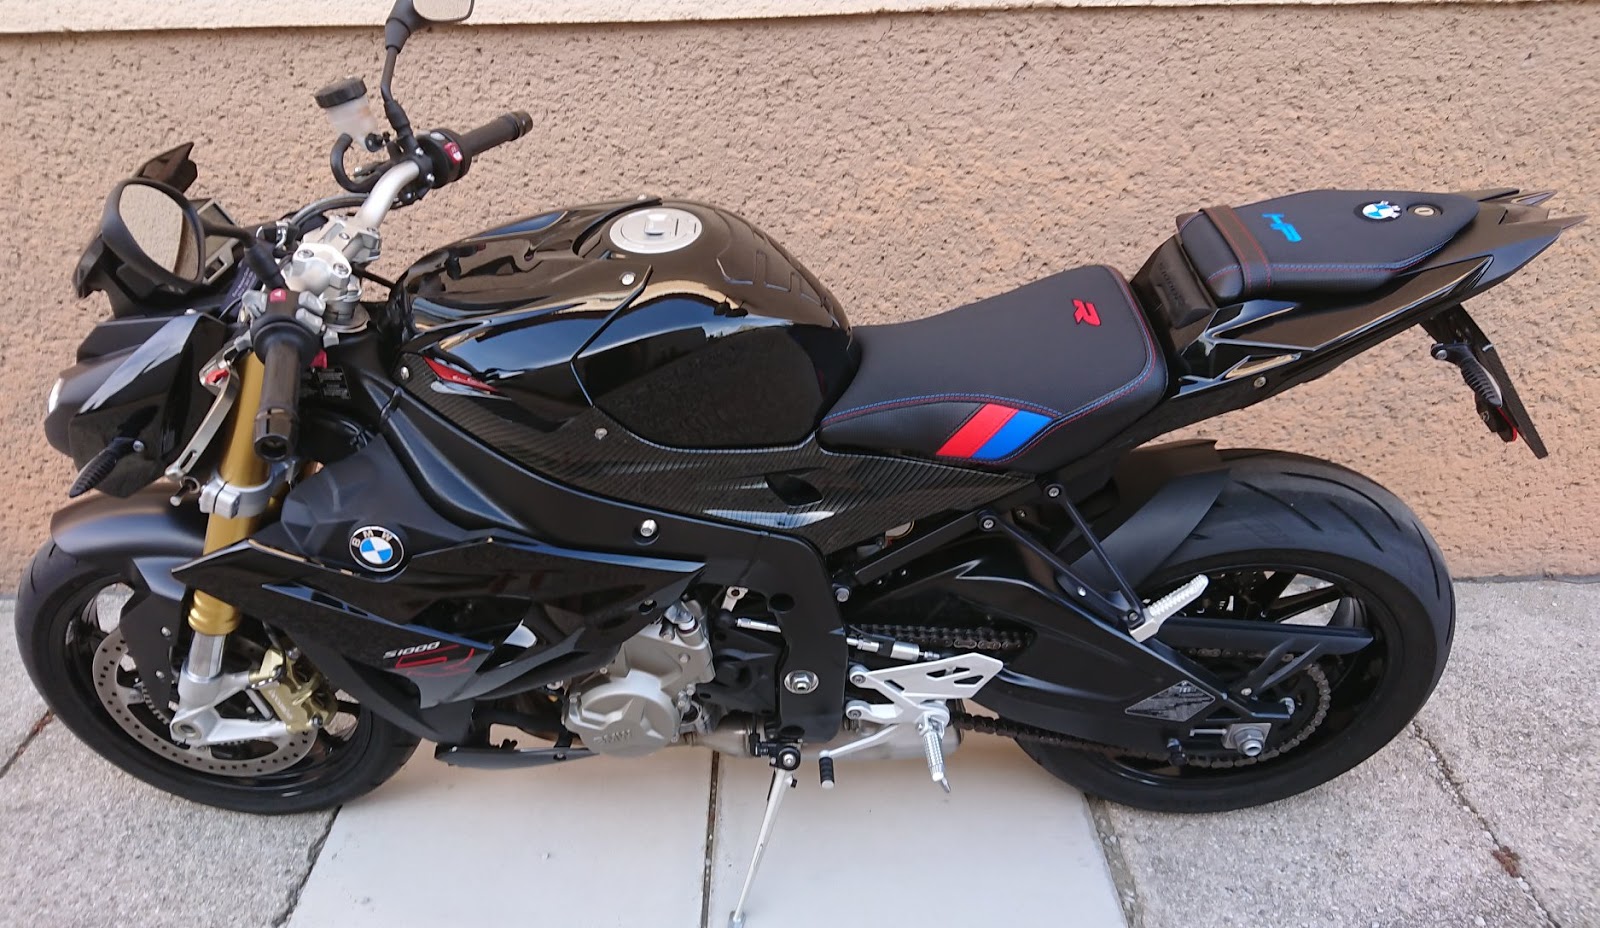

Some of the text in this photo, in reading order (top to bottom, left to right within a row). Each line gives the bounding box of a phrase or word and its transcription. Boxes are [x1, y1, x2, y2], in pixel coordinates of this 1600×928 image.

[1072, 298, 1102, 328] R
[351, 529, 393, 548] BMW
[383, 641, 441, 660] S1000
